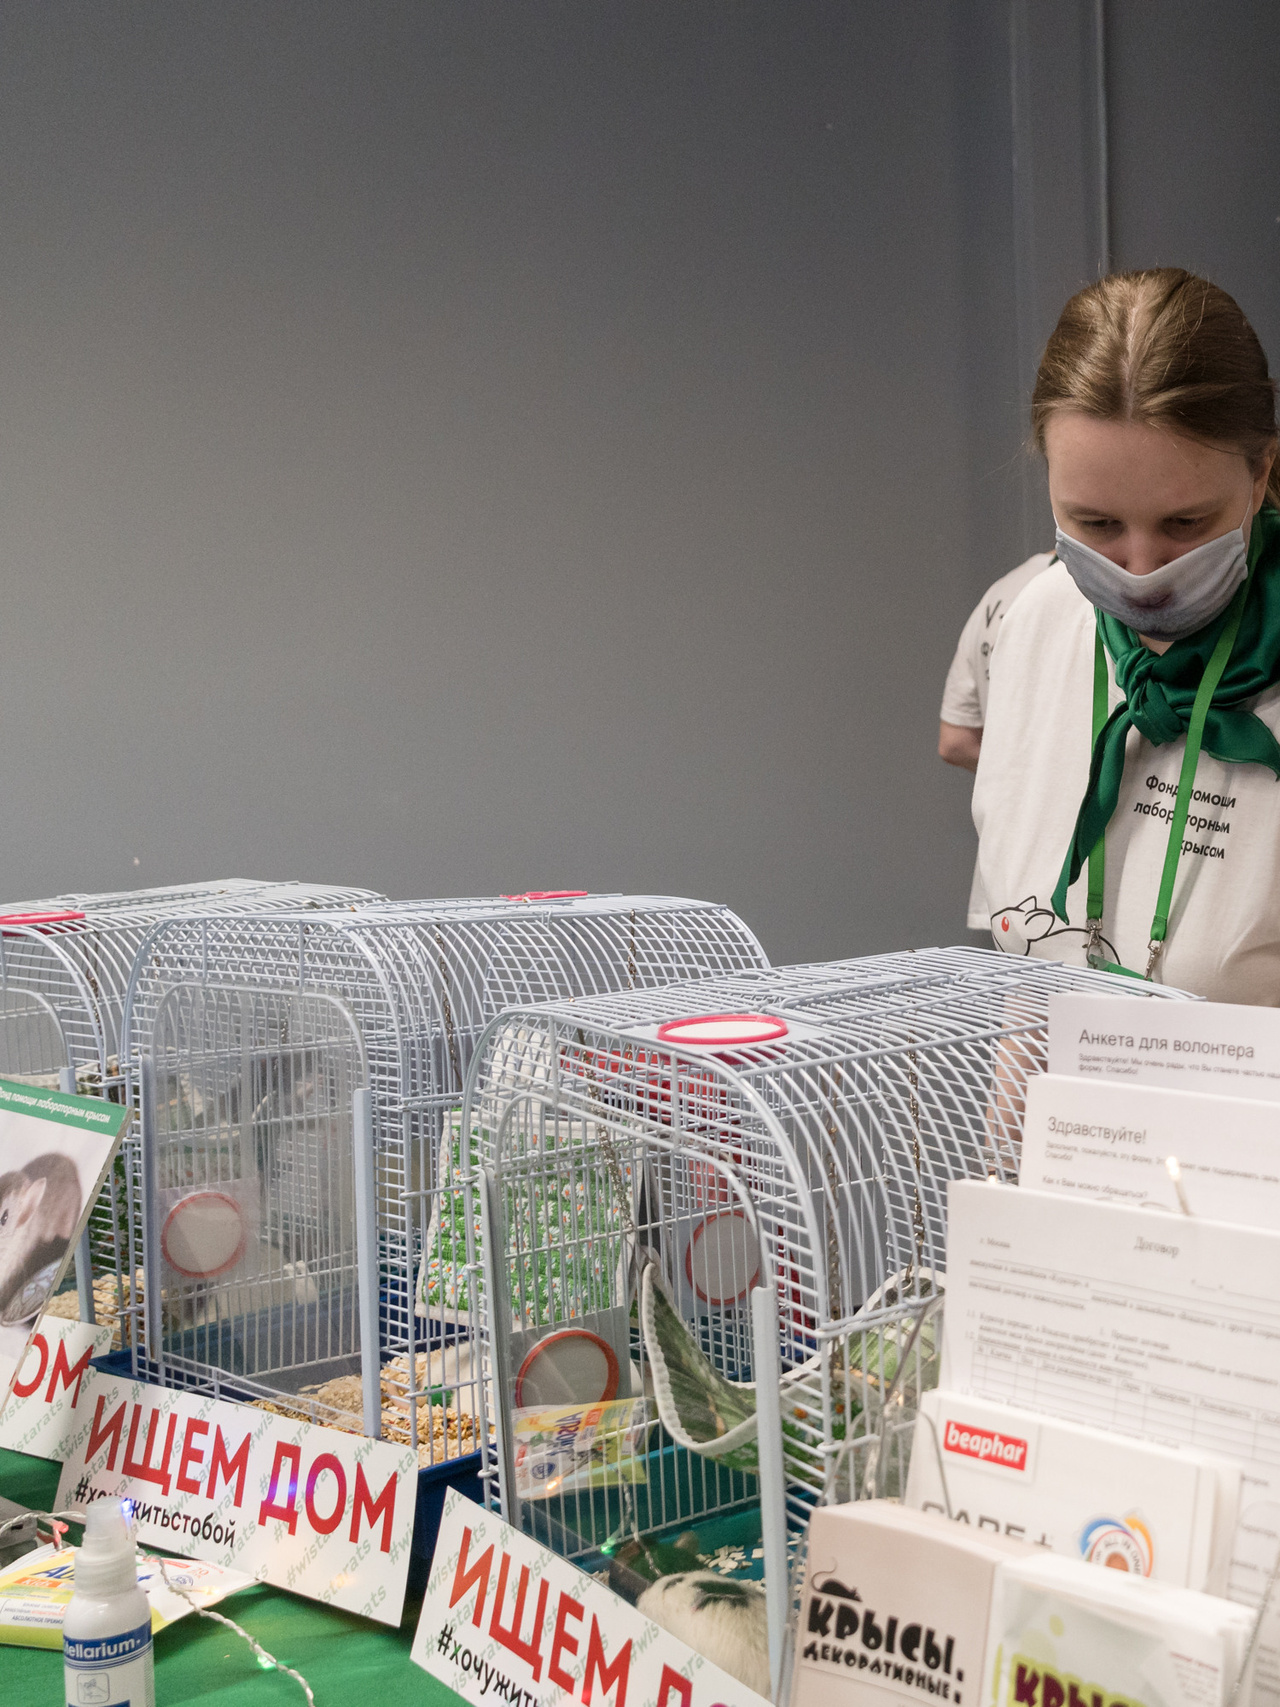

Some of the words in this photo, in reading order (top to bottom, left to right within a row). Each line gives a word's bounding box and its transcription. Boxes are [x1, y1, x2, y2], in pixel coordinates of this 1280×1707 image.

[1079, 1029, 1134, 1047] Анкета
[1139, 1037, 1168, 1051] для
[1173, 1038, 1254, 1060] волонтера
[1048, 1116, 1147, 1144] Здравствуйте!
[1133, 1236, 1180, 1259] Договор
[947, 1423, 1025, 1464] beaphar
[85, 1395, 251, 1508] ИЩЕМ
[258, 1440, 398, 1553] ДОМ
[449, 1525, 634, 1707] ИЩЕМ
